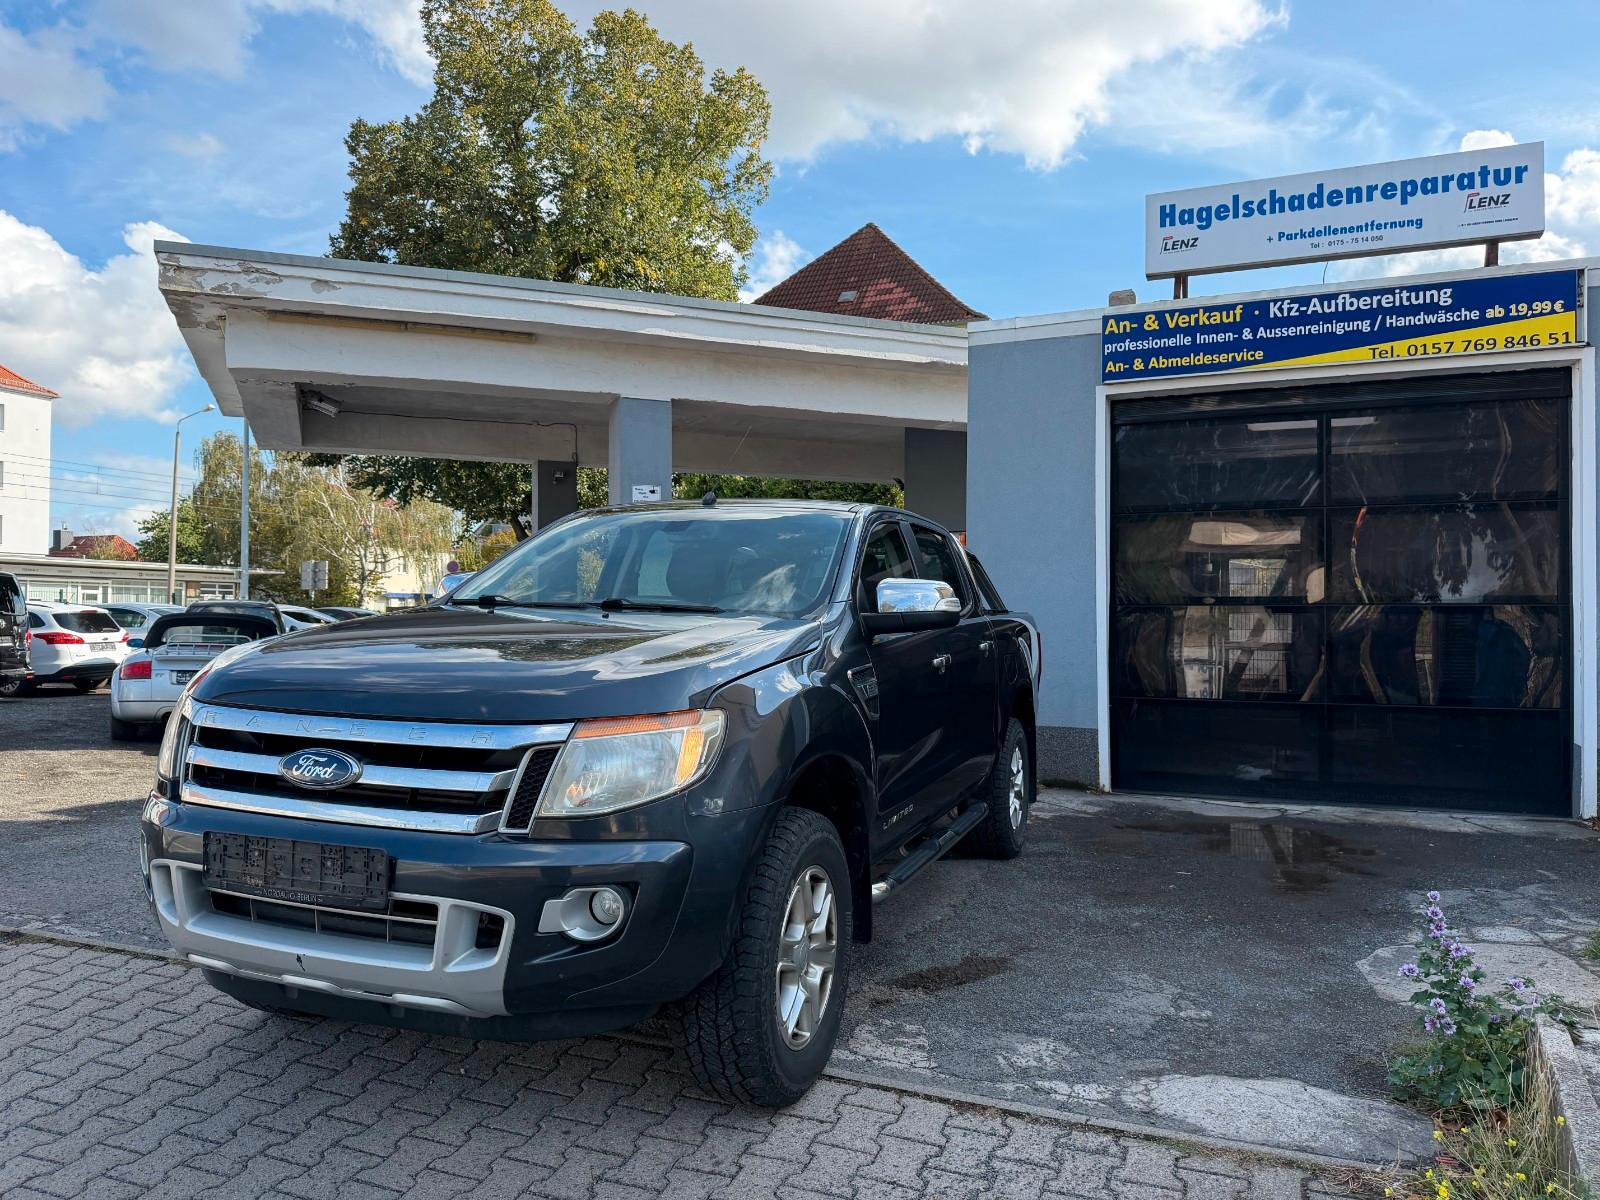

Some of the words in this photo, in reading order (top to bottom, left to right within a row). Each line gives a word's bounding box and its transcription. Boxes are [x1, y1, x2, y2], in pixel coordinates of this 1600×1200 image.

[1159, 164, 1528, 231] Hagelschadenreparatur
[1467, 193, 1511, 210] LENZ
[1277, 217, 1423, 242] Parkdellenentfernung
[1163, 237, 1199, 252] LENZ
[1328, 239, 1345, 247] 0175
[1104, 318, 1138, 335] An-
[1143, 314, 1159, 331] &
[1164, 304, 1243, 329] Verkauf
[1269, 287, 1453, 319] Kfz-Aufbereitung
[1104, 333, 1192, 355] professionelle
[1196, 329, 1239, 344] Innen-
[1242, 328, 1253, 340] &
[1256, 316, 1371, 339] Aussenreinigung
[1374, 314, 1383, 331] /
[1386, 307, 1480, 328] Handwäsche
[1485, 304, 1504, 318] ab
[1368, 346, 1400, 360] Tel.
[1407, 340, 1455, 357] 0157
[1461, 337, 1497, 353] 769
[1503, 333, 1541, 349] 846
[1548, 331, 1572, 345] 51
[1105, 360, 1129, 373] An-
[1132, 357, 1144, 371] &
[1148, 347, 1264, 369] Abmeldeservice
[203, 709, 496, 745] RANGER
[292, 754, 335, 779] Ford
